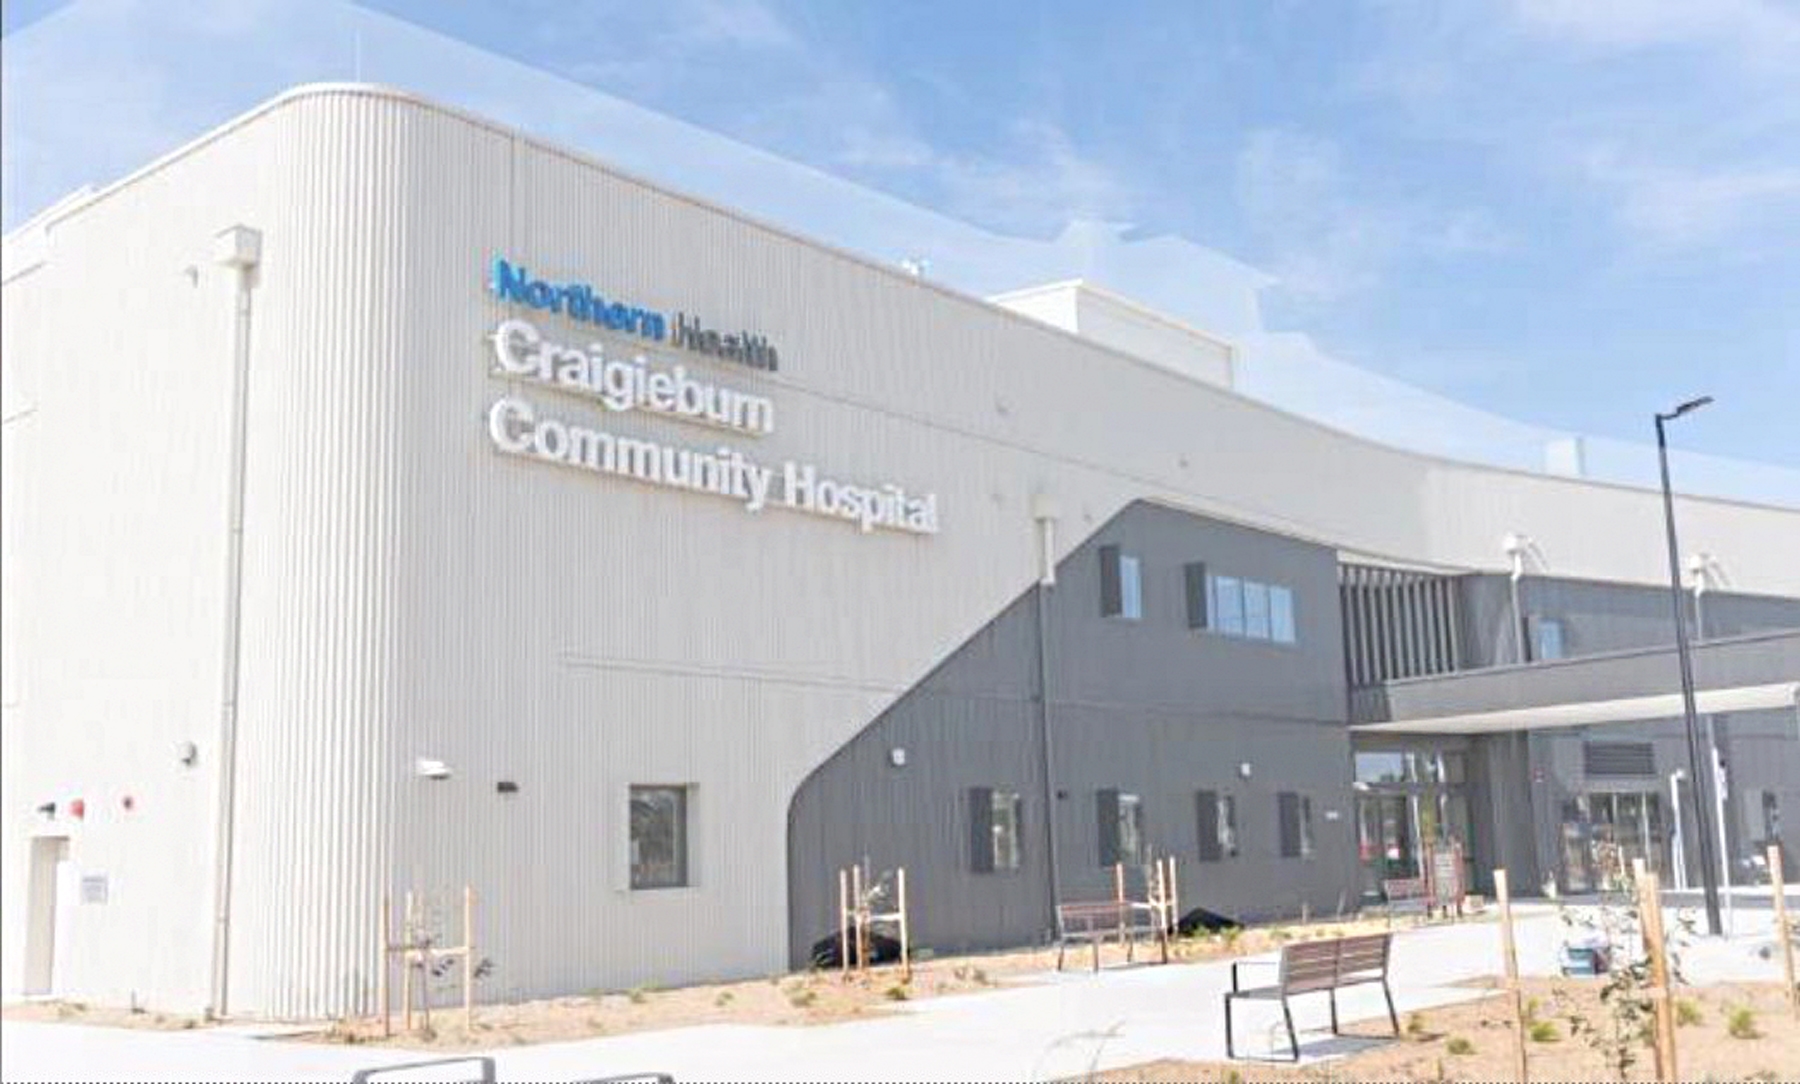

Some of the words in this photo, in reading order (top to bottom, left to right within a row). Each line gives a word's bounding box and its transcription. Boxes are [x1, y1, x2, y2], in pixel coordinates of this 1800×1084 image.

[493, 257, 666, 341] Northern
[492, 319, 774, 434] Craigieburn
[489, 396, 770, 511] Community
[783, 461, 938, 534] Hospital
